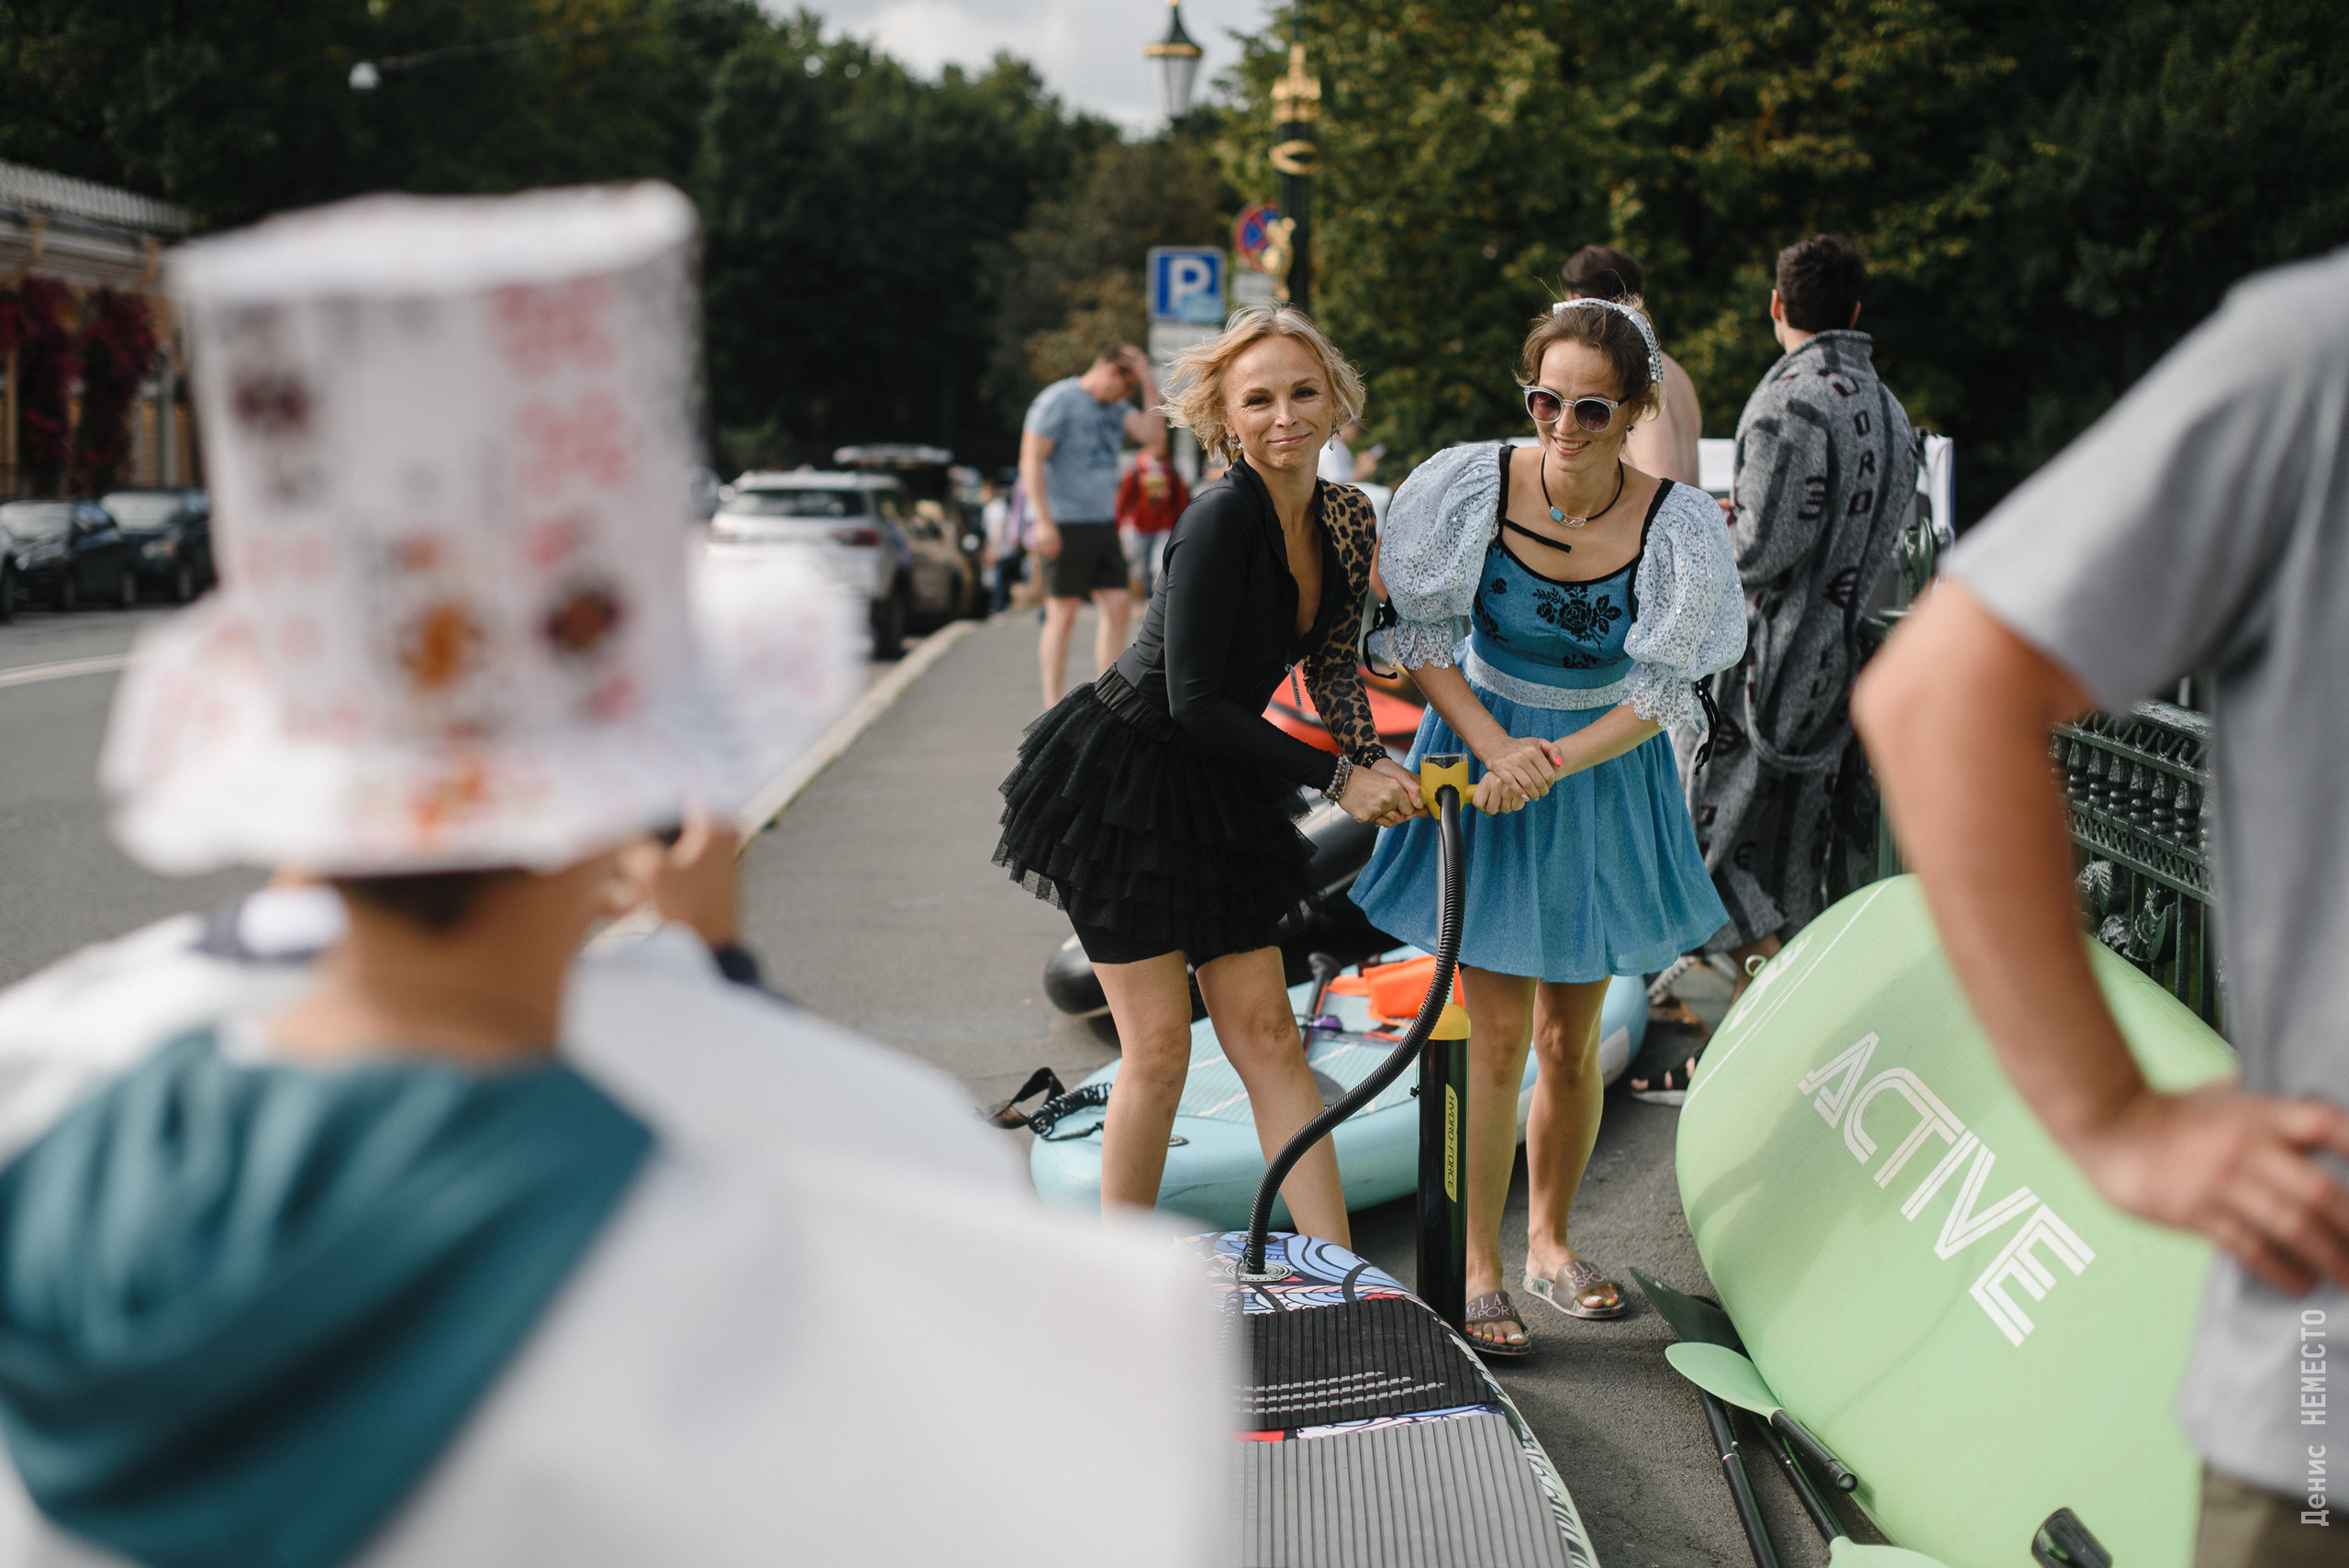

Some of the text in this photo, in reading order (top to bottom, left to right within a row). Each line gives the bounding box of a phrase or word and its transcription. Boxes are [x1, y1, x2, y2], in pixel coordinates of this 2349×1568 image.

[1168, 257, 1213, 310] P
[1447, 1095, 1456, 1190] HYDRO-FORCE
[1798, 1031, 2097, 1348] ACTIVE
